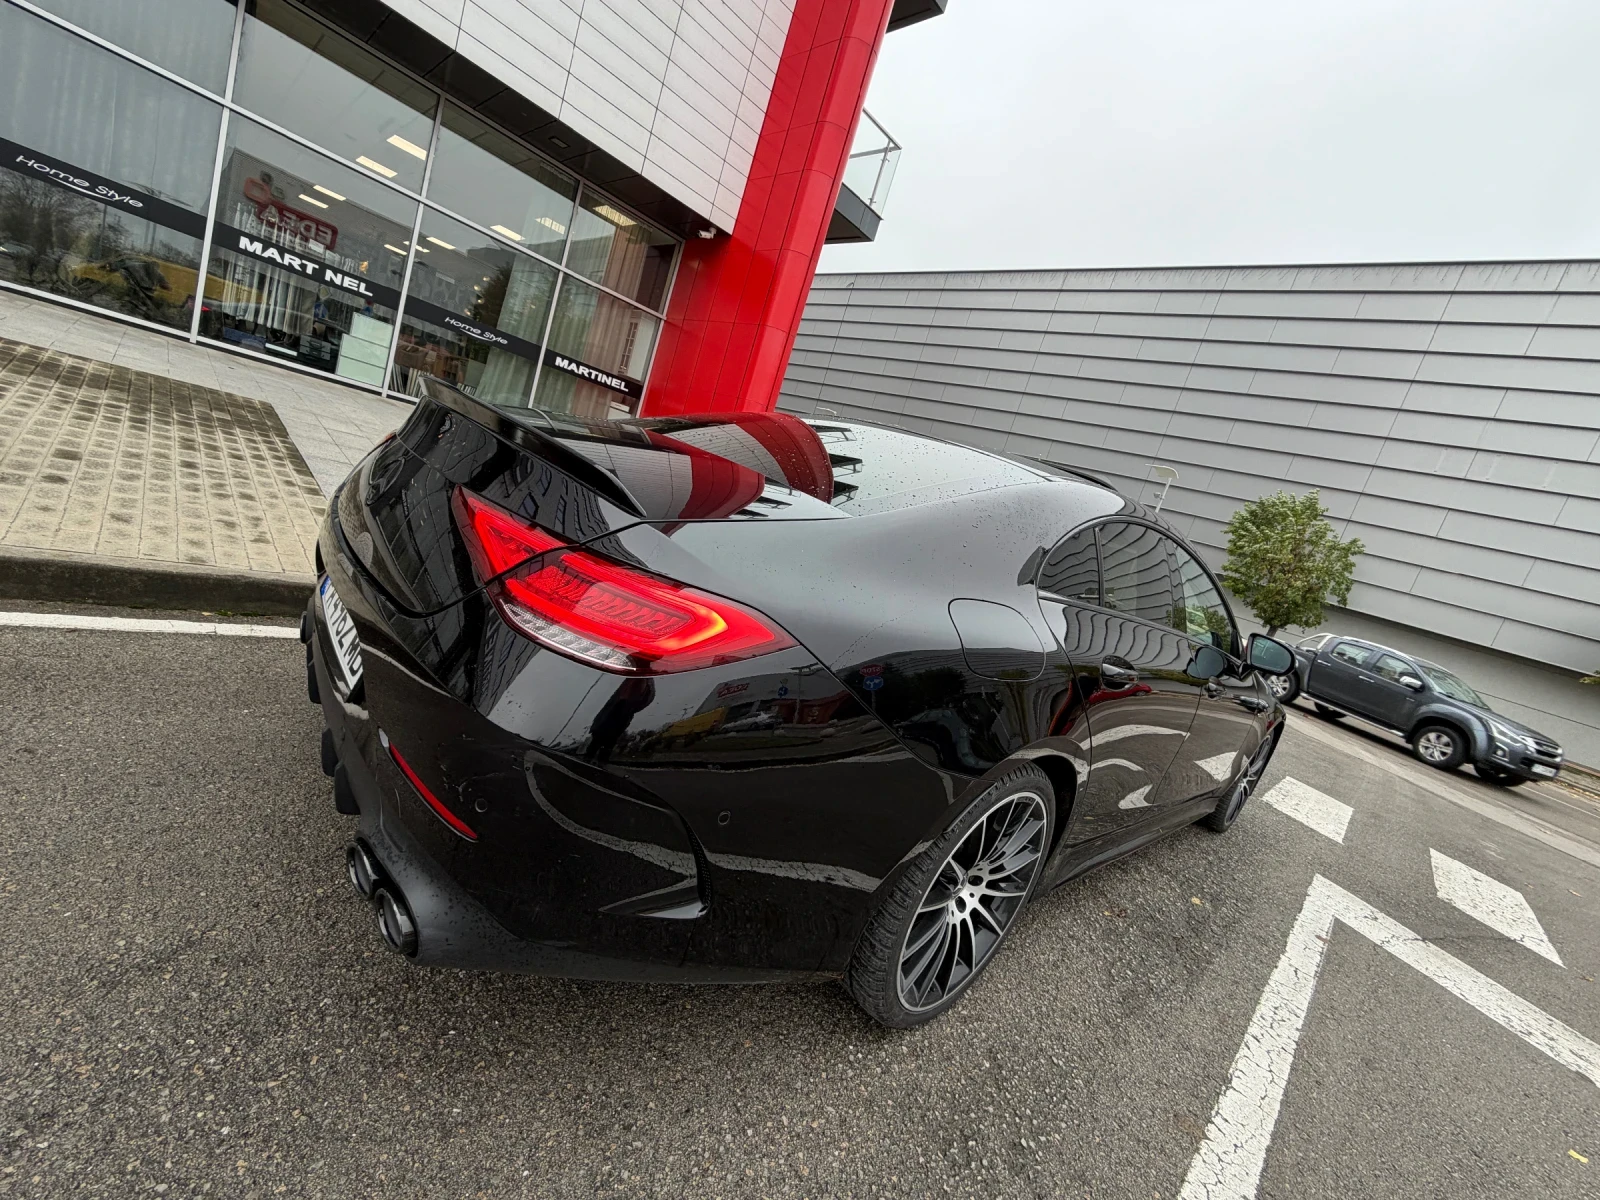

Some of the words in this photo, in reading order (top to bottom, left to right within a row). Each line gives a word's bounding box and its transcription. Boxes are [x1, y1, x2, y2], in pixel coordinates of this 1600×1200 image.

[15, 155, 91, 188] Home
[95, 185, 144, 208] Style
[444, 316, 481, 334] Home
[484, 330, 508, 345] Style
[555, 356, 629, 392] MARTINEL
